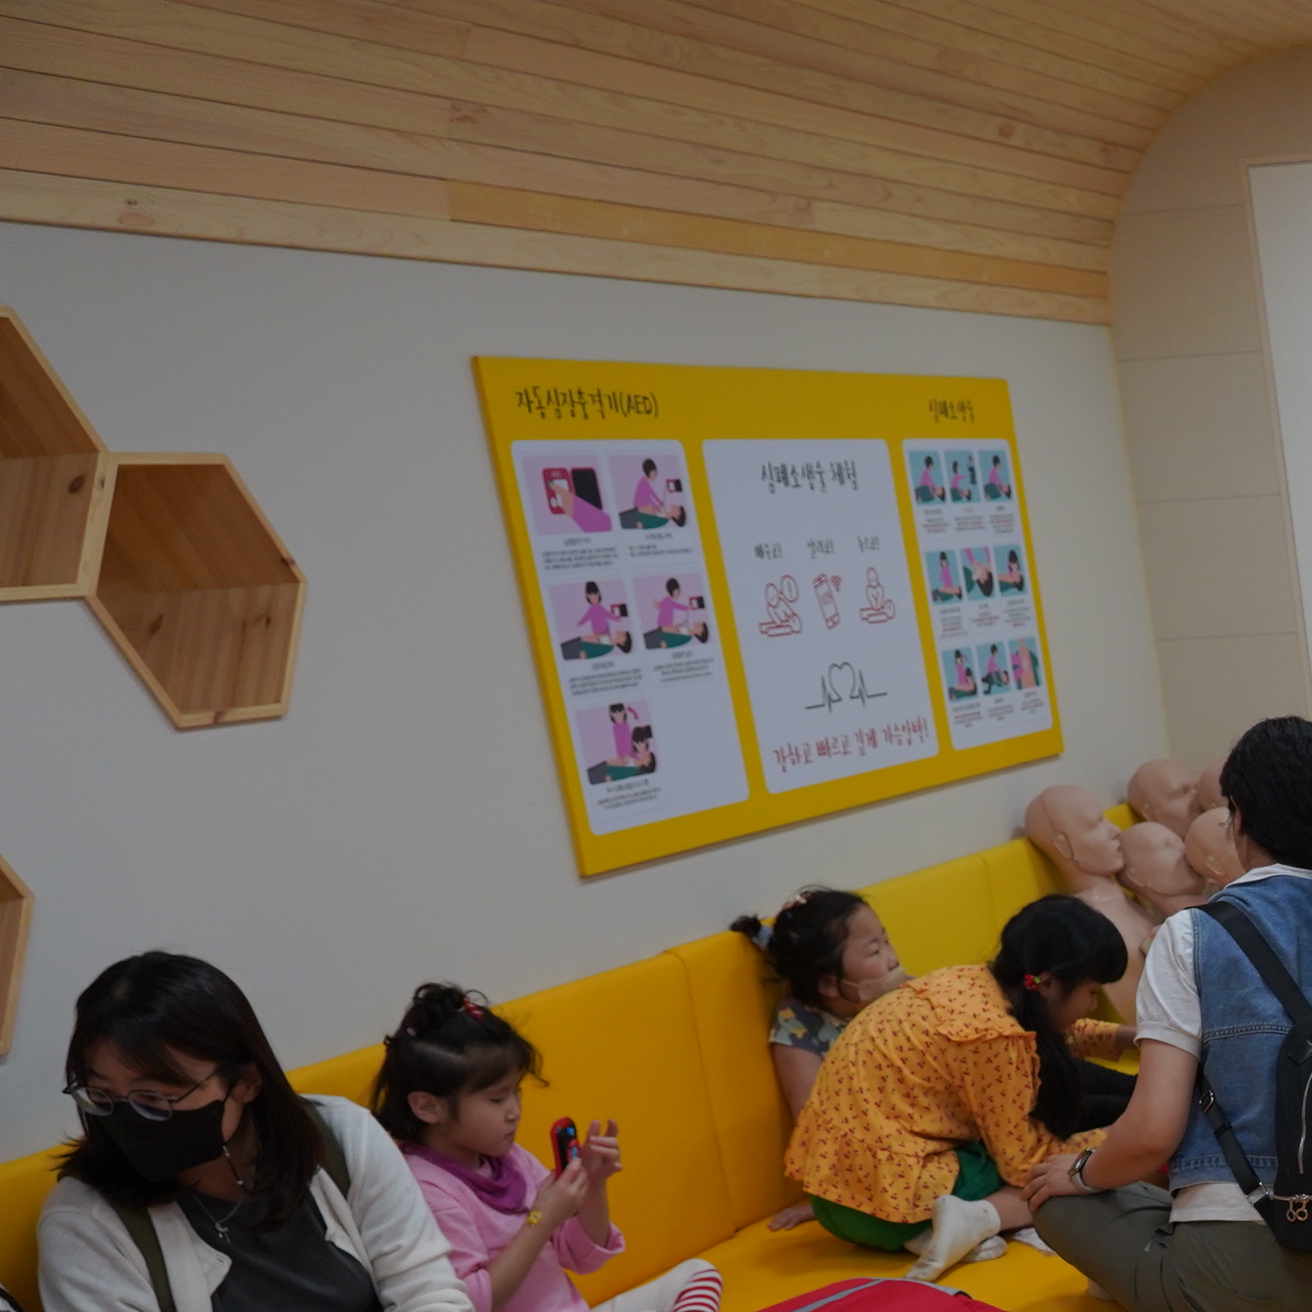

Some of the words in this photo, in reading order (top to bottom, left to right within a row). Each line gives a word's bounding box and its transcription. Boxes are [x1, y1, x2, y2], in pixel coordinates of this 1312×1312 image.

[761, 461, 828, 494] 심폐소생술
[830, 459, 858, 491] 체험
[815, 733, 851, 758] 빠르고
